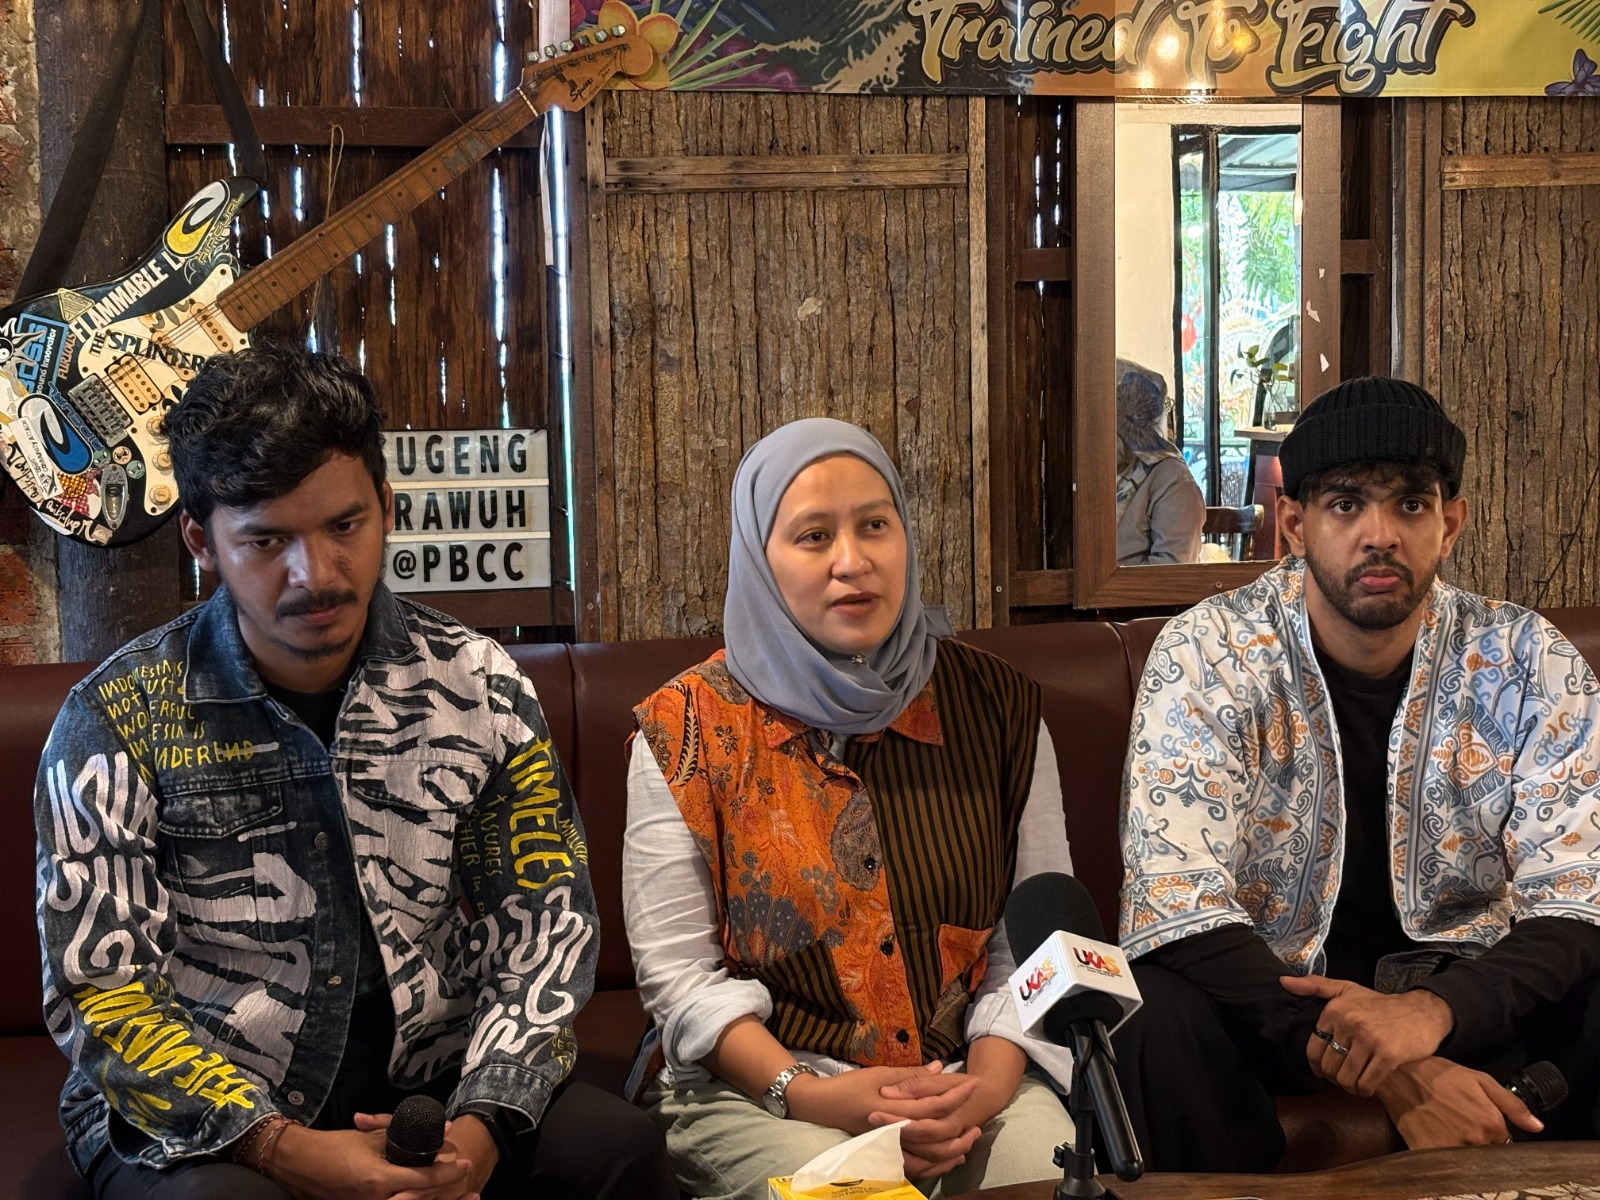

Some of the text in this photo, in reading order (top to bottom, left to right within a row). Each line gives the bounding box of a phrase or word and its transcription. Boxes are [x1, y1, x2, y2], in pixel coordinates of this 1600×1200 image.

[906, 0, 1153, 85] Trained
[63, 292, 89, 306] CAUTION
[68, 258, 170, 344] FLAMMABLE
[57, 331, 77, 380] FURIOUS
[89, 330, 107, 356] THE
[394, 489, 527, 531] RAWUH
[392, 541, 525, 583] @PBCC
